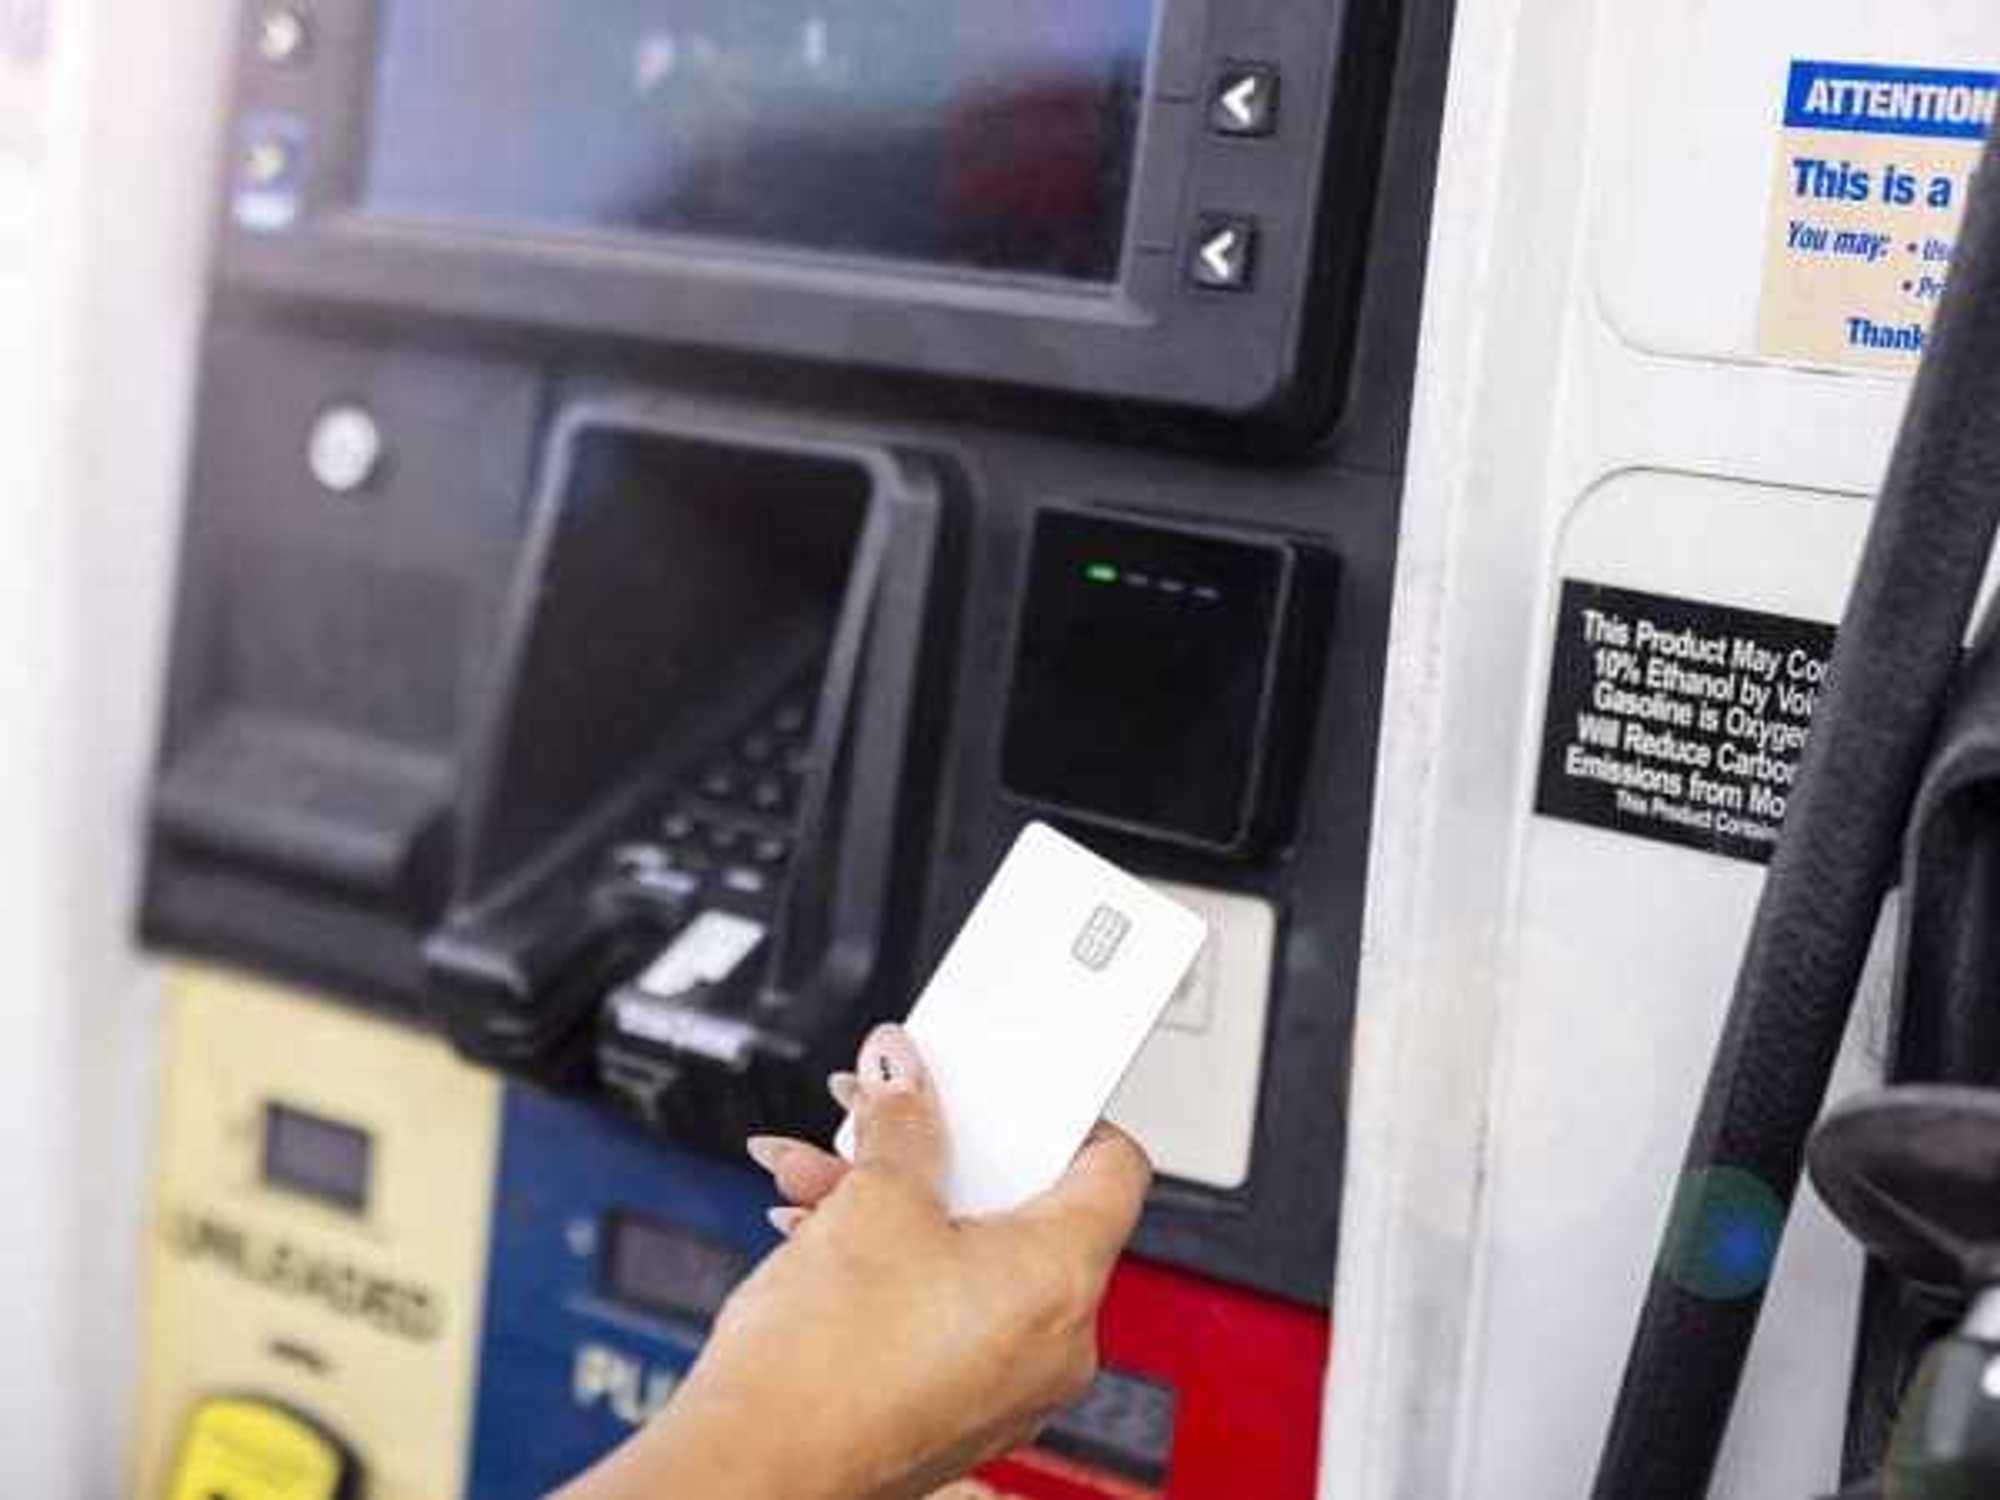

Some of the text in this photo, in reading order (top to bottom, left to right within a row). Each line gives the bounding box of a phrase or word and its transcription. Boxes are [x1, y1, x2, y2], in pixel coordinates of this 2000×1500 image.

[1802, 79, 1997, 124] ATTENTION
[1793, 158, 1952, 208] This is a
[1788, 221, 1828, 251] You
[1833, 230, 1891, 262] may:
[1582, 609, 1630, 647] This
[1635, 619, 1728, 666] Product
[1730, 637, 1783, 681] May
[1593, 680, 1694, 727] Gasoline
[1698, 700, 1720, 732] is
[1594, 646, 1641, 686] 10%
[1646, 656, 1736, 702] Ethanol
[1740, 674, 1772, 715] by
[1577, 710, 1620, 749] Will
[1622, 722, 1711, 768] Reduce
[1564, 743, 1786, 819] Emissions from Mo
